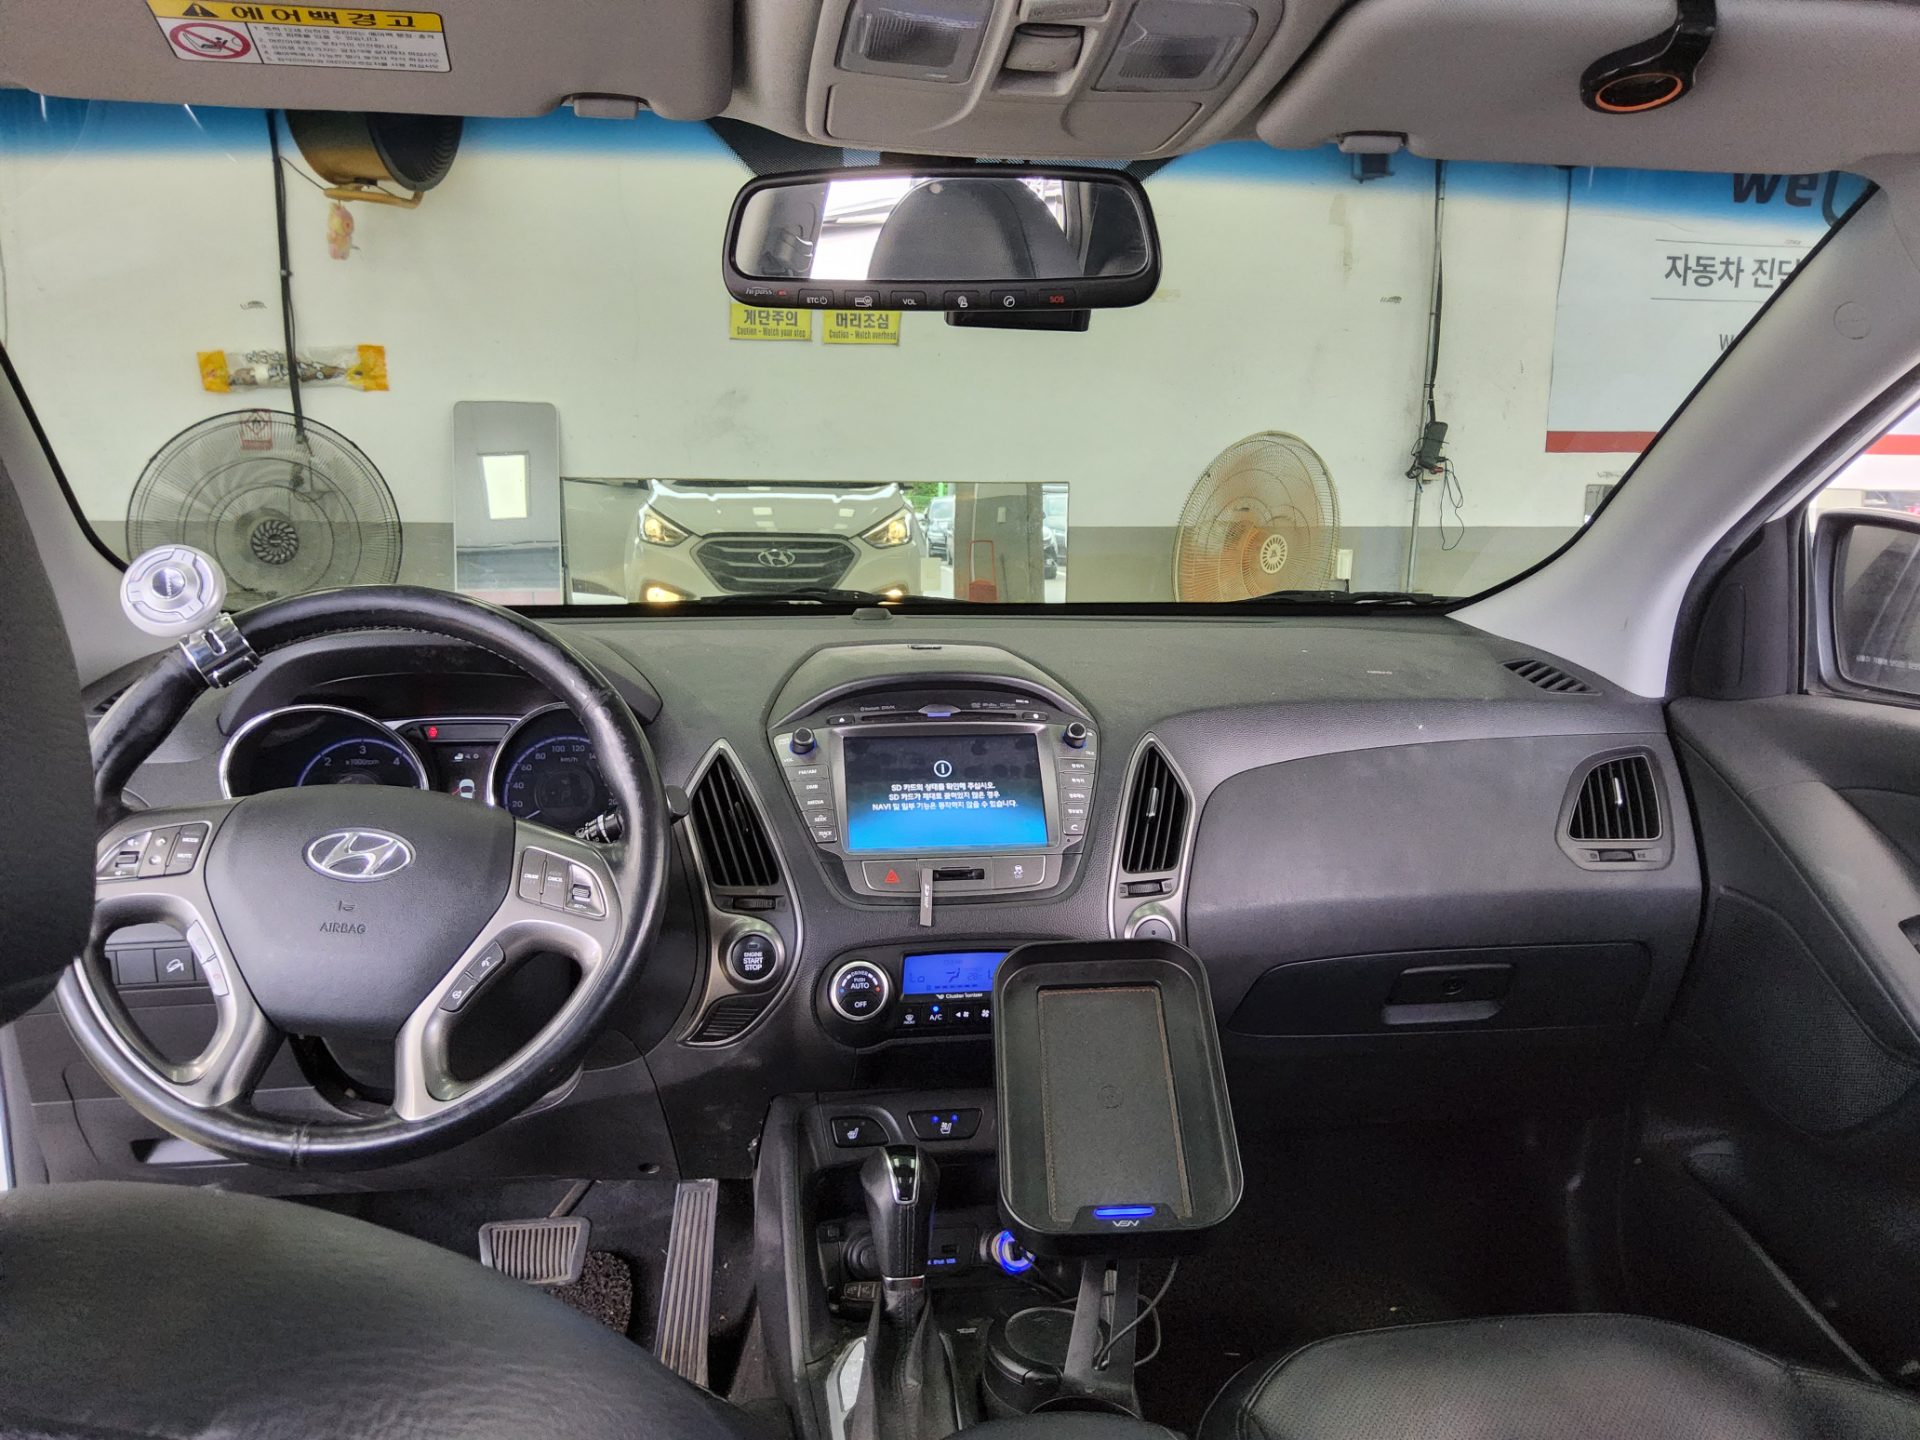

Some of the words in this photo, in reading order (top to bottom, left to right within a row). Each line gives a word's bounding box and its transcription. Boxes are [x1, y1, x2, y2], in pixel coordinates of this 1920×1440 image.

[1664, 253, 1745, 289] 자동차
[1049, 295, 1065, 303] SOS
[743, 309, 798, 327] 계단주의
[835, 312, 889, 329] 머리조심
[736, 326, 757, 336] Caution
[763, 327, 779, 337] Watch
[829, 329, 849, 339] Caution
[855, 330, 871, 339] Watch
[359, 745, 367, 754] 3
[324, 757, 332, 766] 2
[393, 757, 400, 765] 4
[891, 784, 902, 792] SD
[888, 793, 900, 801] SD
[872, 803, 892, 811] NAVI
[320, 922, 367, 935] AIRBAG
[850, 982, 870, 990] AUTO
[854, 1000, 867, 1008] OFF
[929, 1013, 943, 1021] A/C
